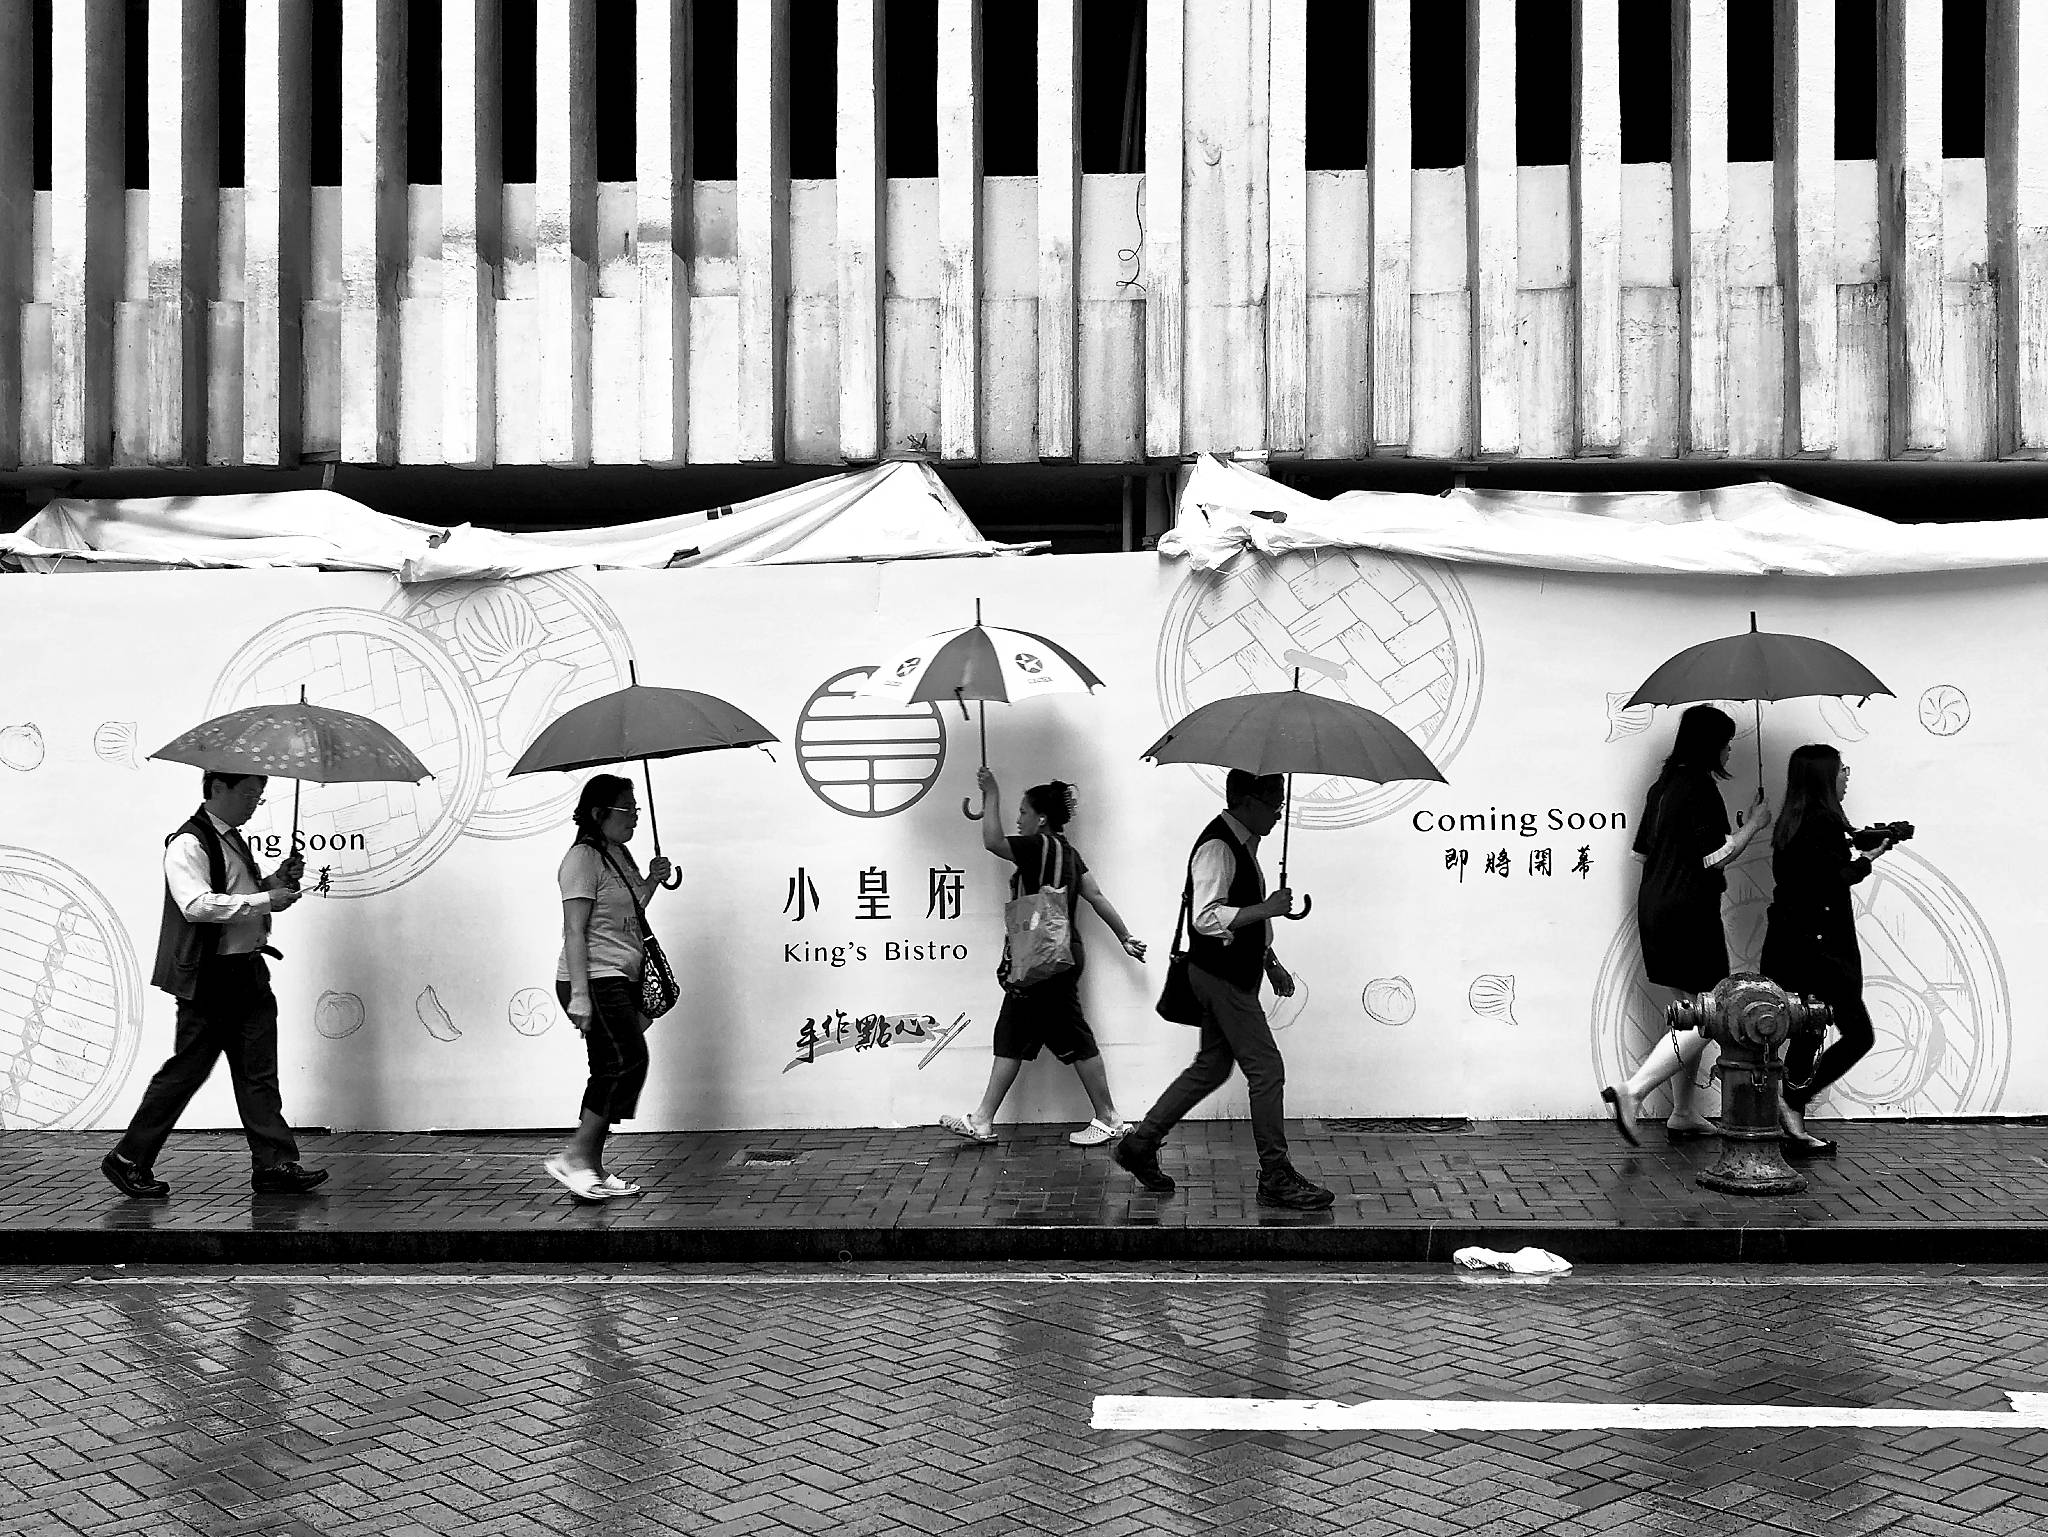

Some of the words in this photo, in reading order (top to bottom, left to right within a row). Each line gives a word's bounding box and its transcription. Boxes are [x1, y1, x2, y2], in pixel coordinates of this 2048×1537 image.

[1413, 807, 1538, 837] Coming
[1548, 808, 1627, 831] Soon
[292, 830, 365, 851] Soon
[1445, 845, 1594, 883] 即將開幕
[783, 864, 965, 922] 小皇府
[885, 939, 968, 961] Bistro
[796, 1009, 936, 1063] 手作點心
